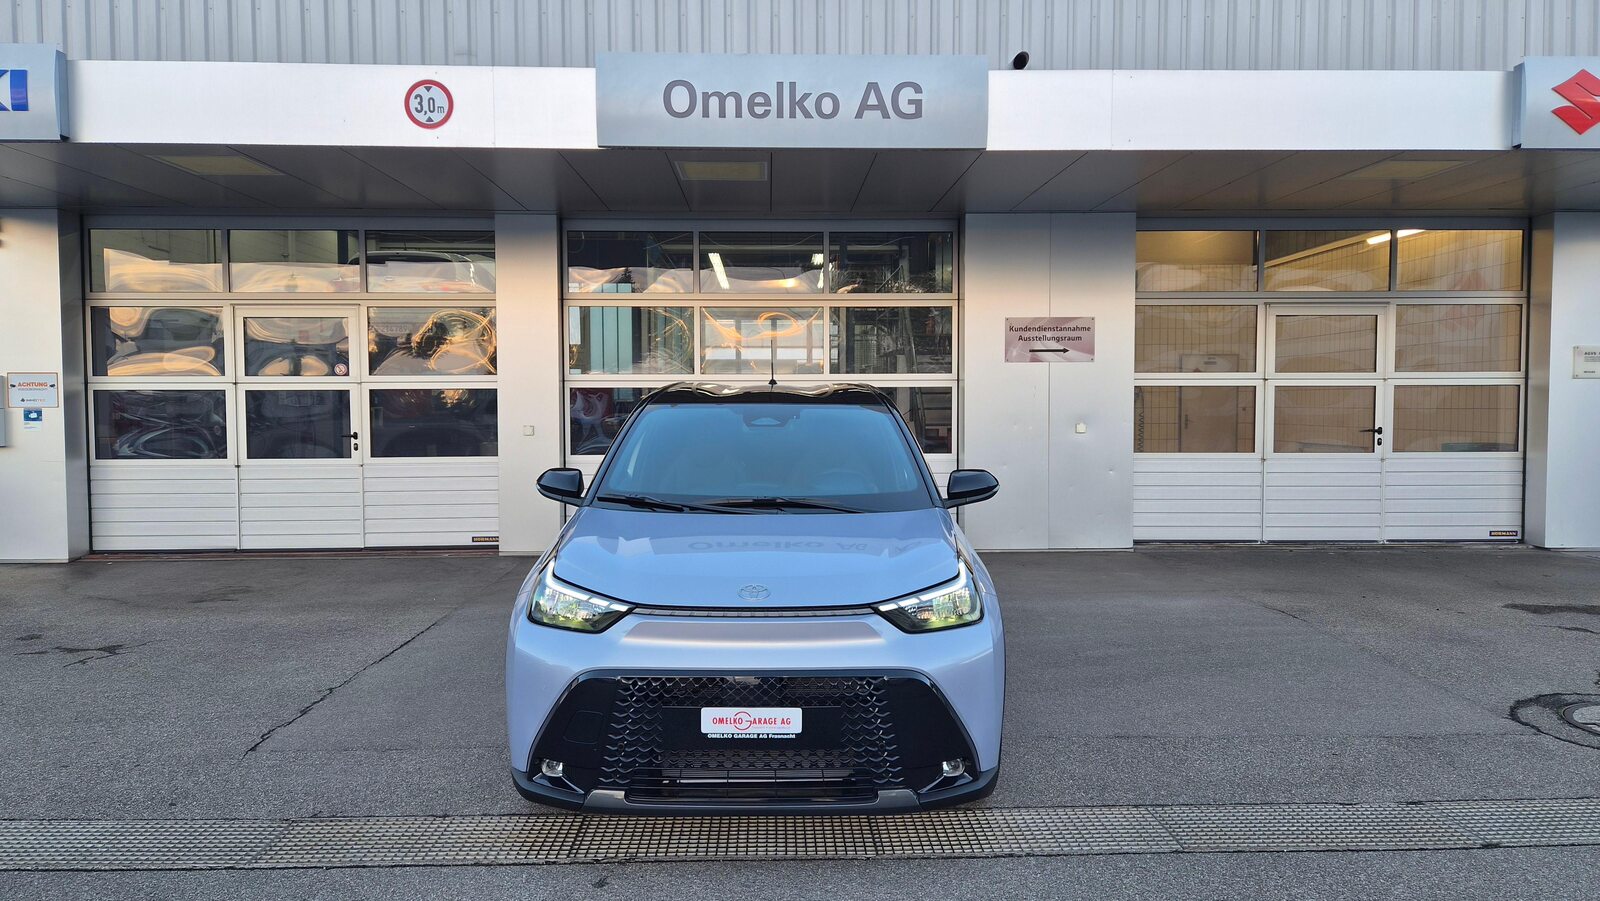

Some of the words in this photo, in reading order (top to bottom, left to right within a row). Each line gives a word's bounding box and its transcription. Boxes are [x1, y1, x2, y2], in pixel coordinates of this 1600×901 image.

[663, 79, 840, 119] Omelko
[854, 81, 923, 119] AG
[1018, 335, 1082, 343] Ausstellungsraum
[712, 717, 743, 725] OMELKO
